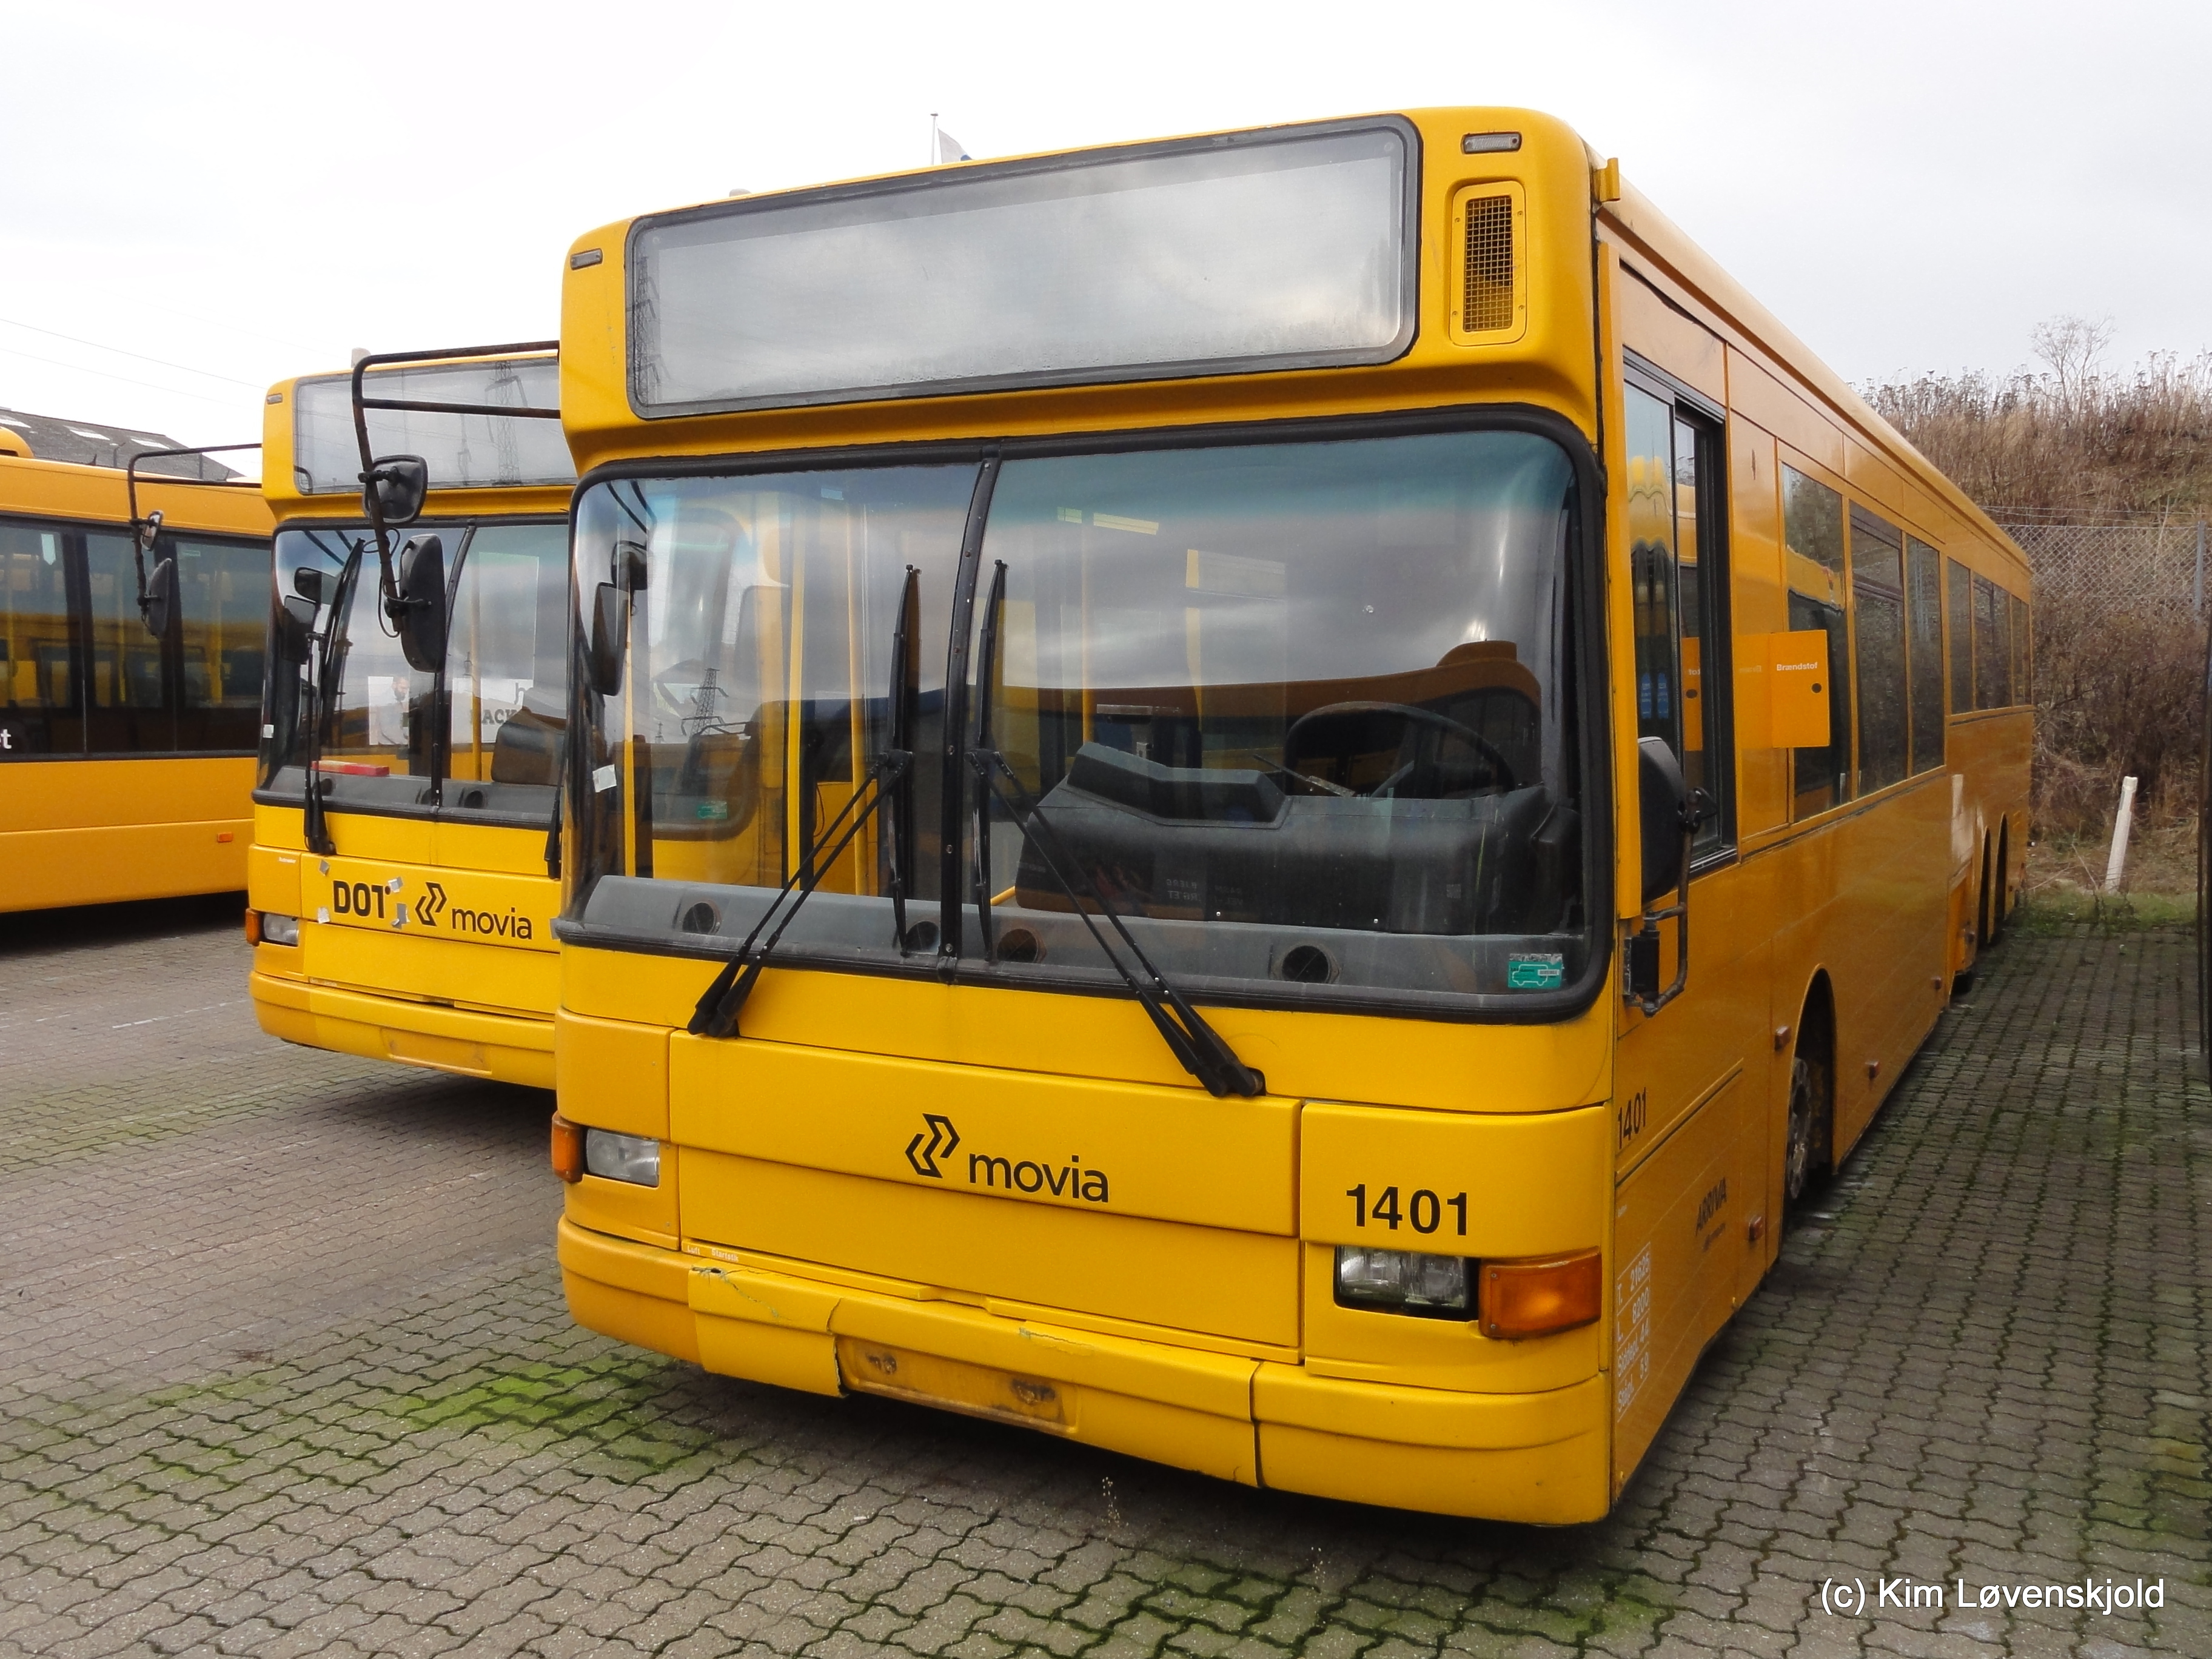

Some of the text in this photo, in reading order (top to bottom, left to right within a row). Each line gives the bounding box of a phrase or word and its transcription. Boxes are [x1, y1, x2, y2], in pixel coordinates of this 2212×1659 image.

[1776, 662, 1818, 671] Brændstof
[333, 880, 386, 919] DOT
[451, 907, 533, 939] movia
[1618, 1087, 1647, 1150] 1401
[969, 1153, 1109, 1203] movia
[1346, 1183, 1468, 1236] 1401
[1695, 1177, 1728, 1236] ARRIVA
